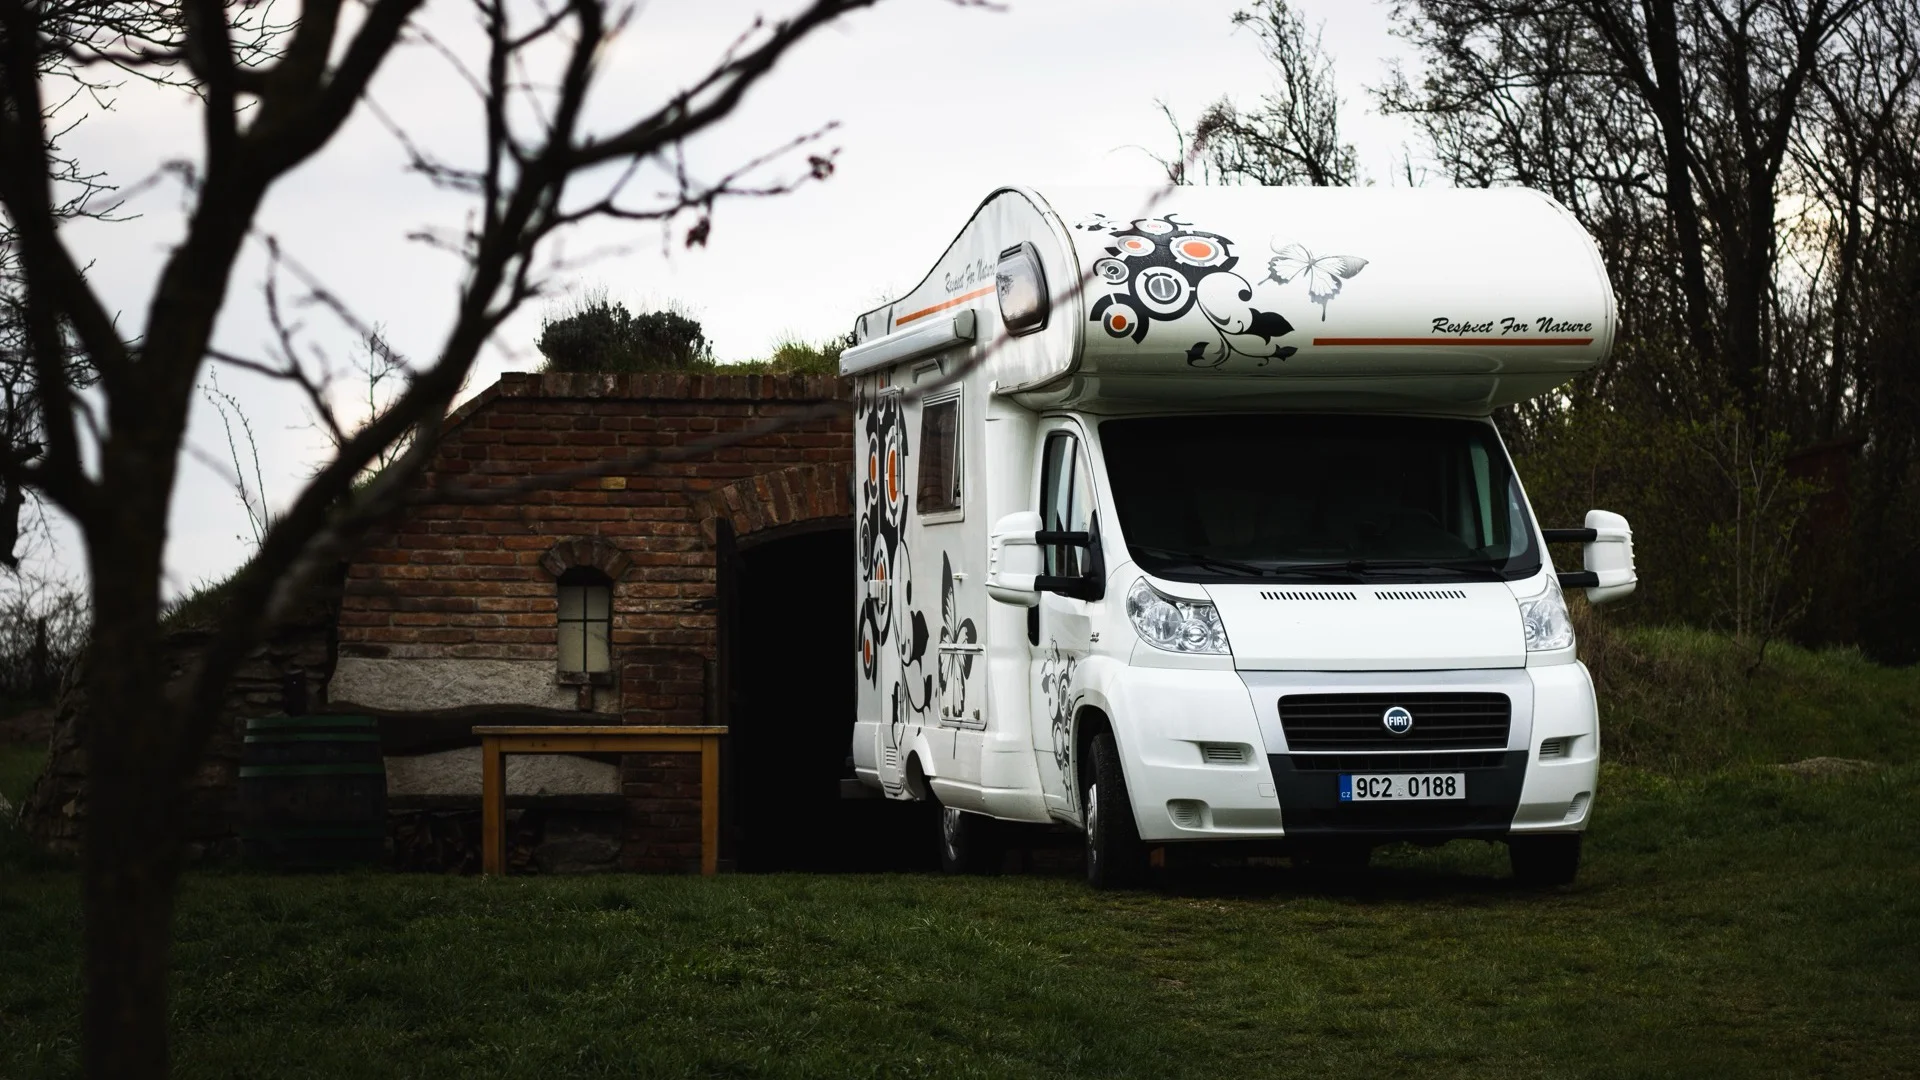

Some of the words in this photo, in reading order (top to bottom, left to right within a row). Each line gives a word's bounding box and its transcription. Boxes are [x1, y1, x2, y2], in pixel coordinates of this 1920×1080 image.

[1432, 317, 1493, 336] Respect
[1500, 317, 1528, 335] For
[1536, 317, 1592, 333] Nature
[1388, 716, 1408, 726] FIAT
[1356, 777, 1393, 798] 9C2
[1408, 776, 1457, 797] 0188
